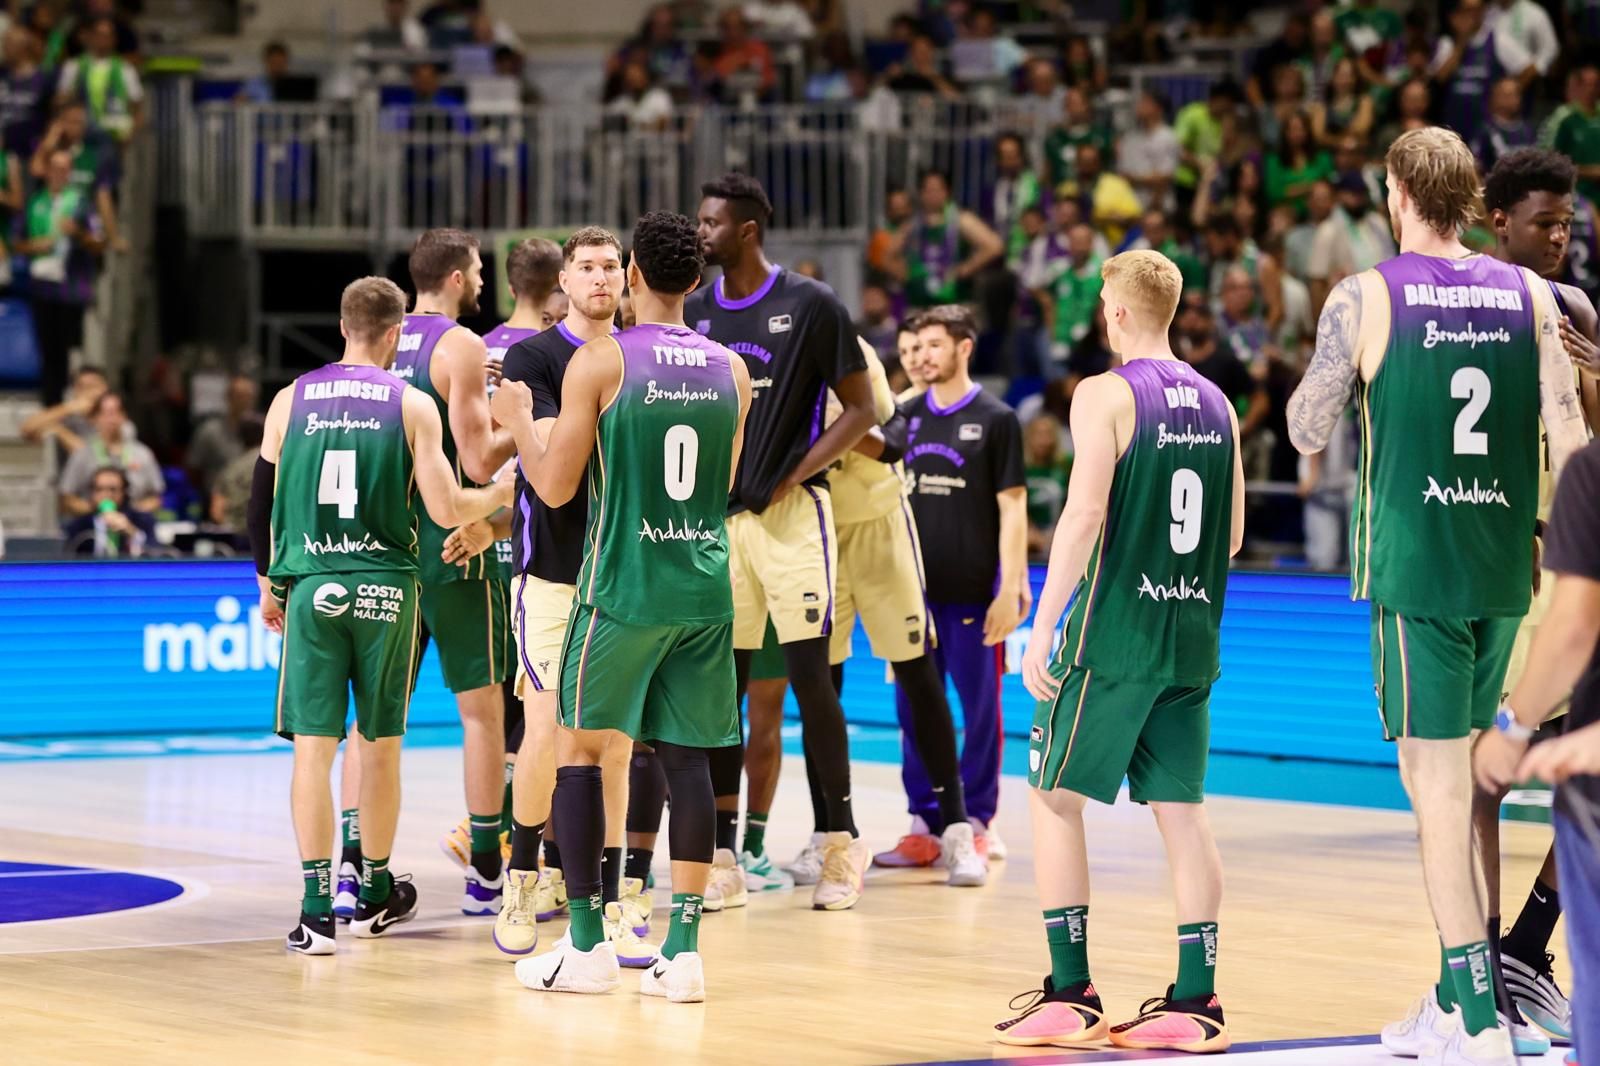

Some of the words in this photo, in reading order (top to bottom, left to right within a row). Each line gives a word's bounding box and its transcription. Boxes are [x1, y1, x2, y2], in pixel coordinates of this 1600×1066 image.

[1403, 284, 1524, 312] BALCEROWSKI
[652, 345, 708, 367] TYSON
[303, 380, 391, 402] KALINOSKI
[1450, 367, 1491, 455] 2
[664, 424, 699, 501] 0
[318, 449, 358, 519] 4
[1169, 468, 1203, 554] 9
[354, 597, 380, 610] DEL
[380, 599, 402, 614] SOL
[356, 583, 405, 602] COSTA
[352, 608, 398, 624] MÁLAGA
[1066, 915, 1084, 944] UNICAJ
